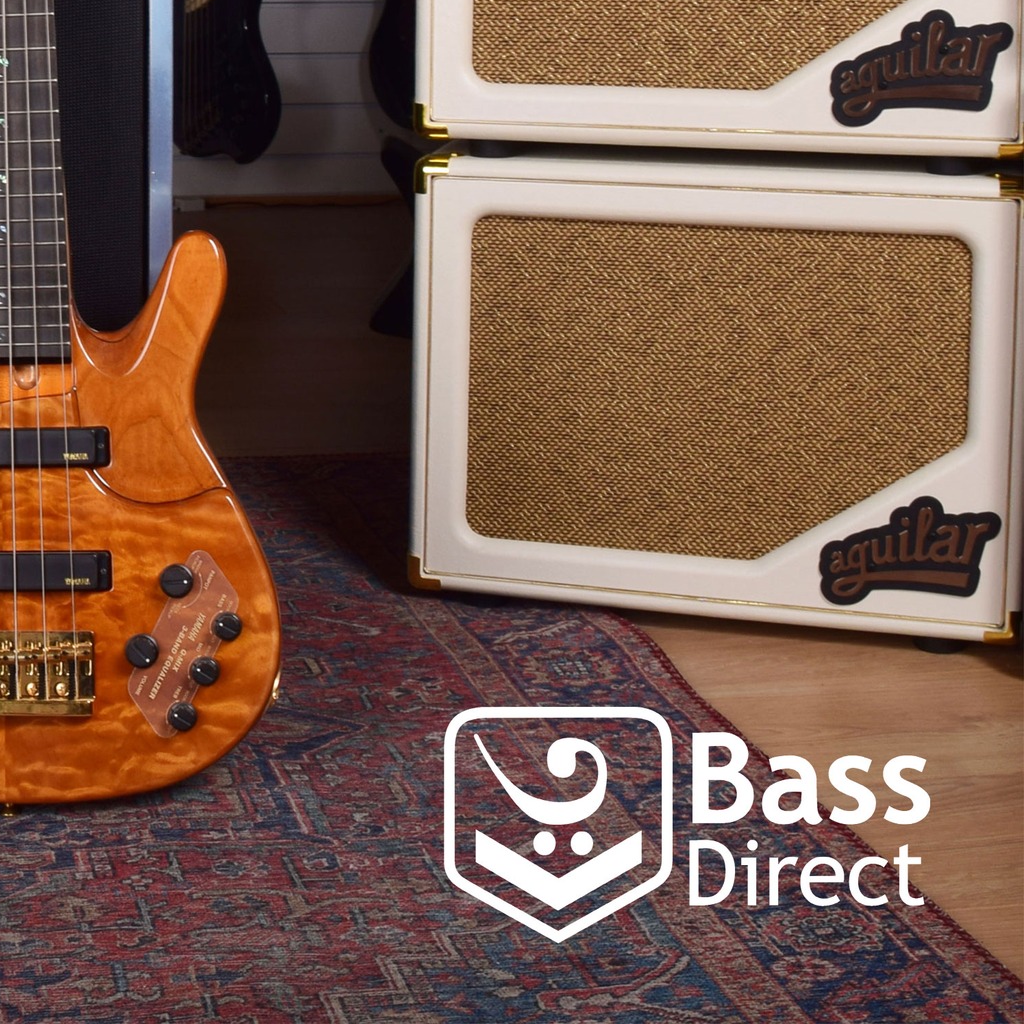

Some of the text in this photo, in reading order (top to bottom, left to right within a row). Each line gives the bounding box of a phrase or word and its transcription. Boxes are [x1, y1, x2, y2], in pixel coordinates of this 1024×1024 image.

[840, 20, 1003, 117] aguilar
[829, 506, 990, 597] aguilar
[148, 625, 189, 700] 3-BAND EQUALIZER
[172, 612, 206, 672] YAMAHA Q-MIX
[134, 675, 148, 696] VOLUME
